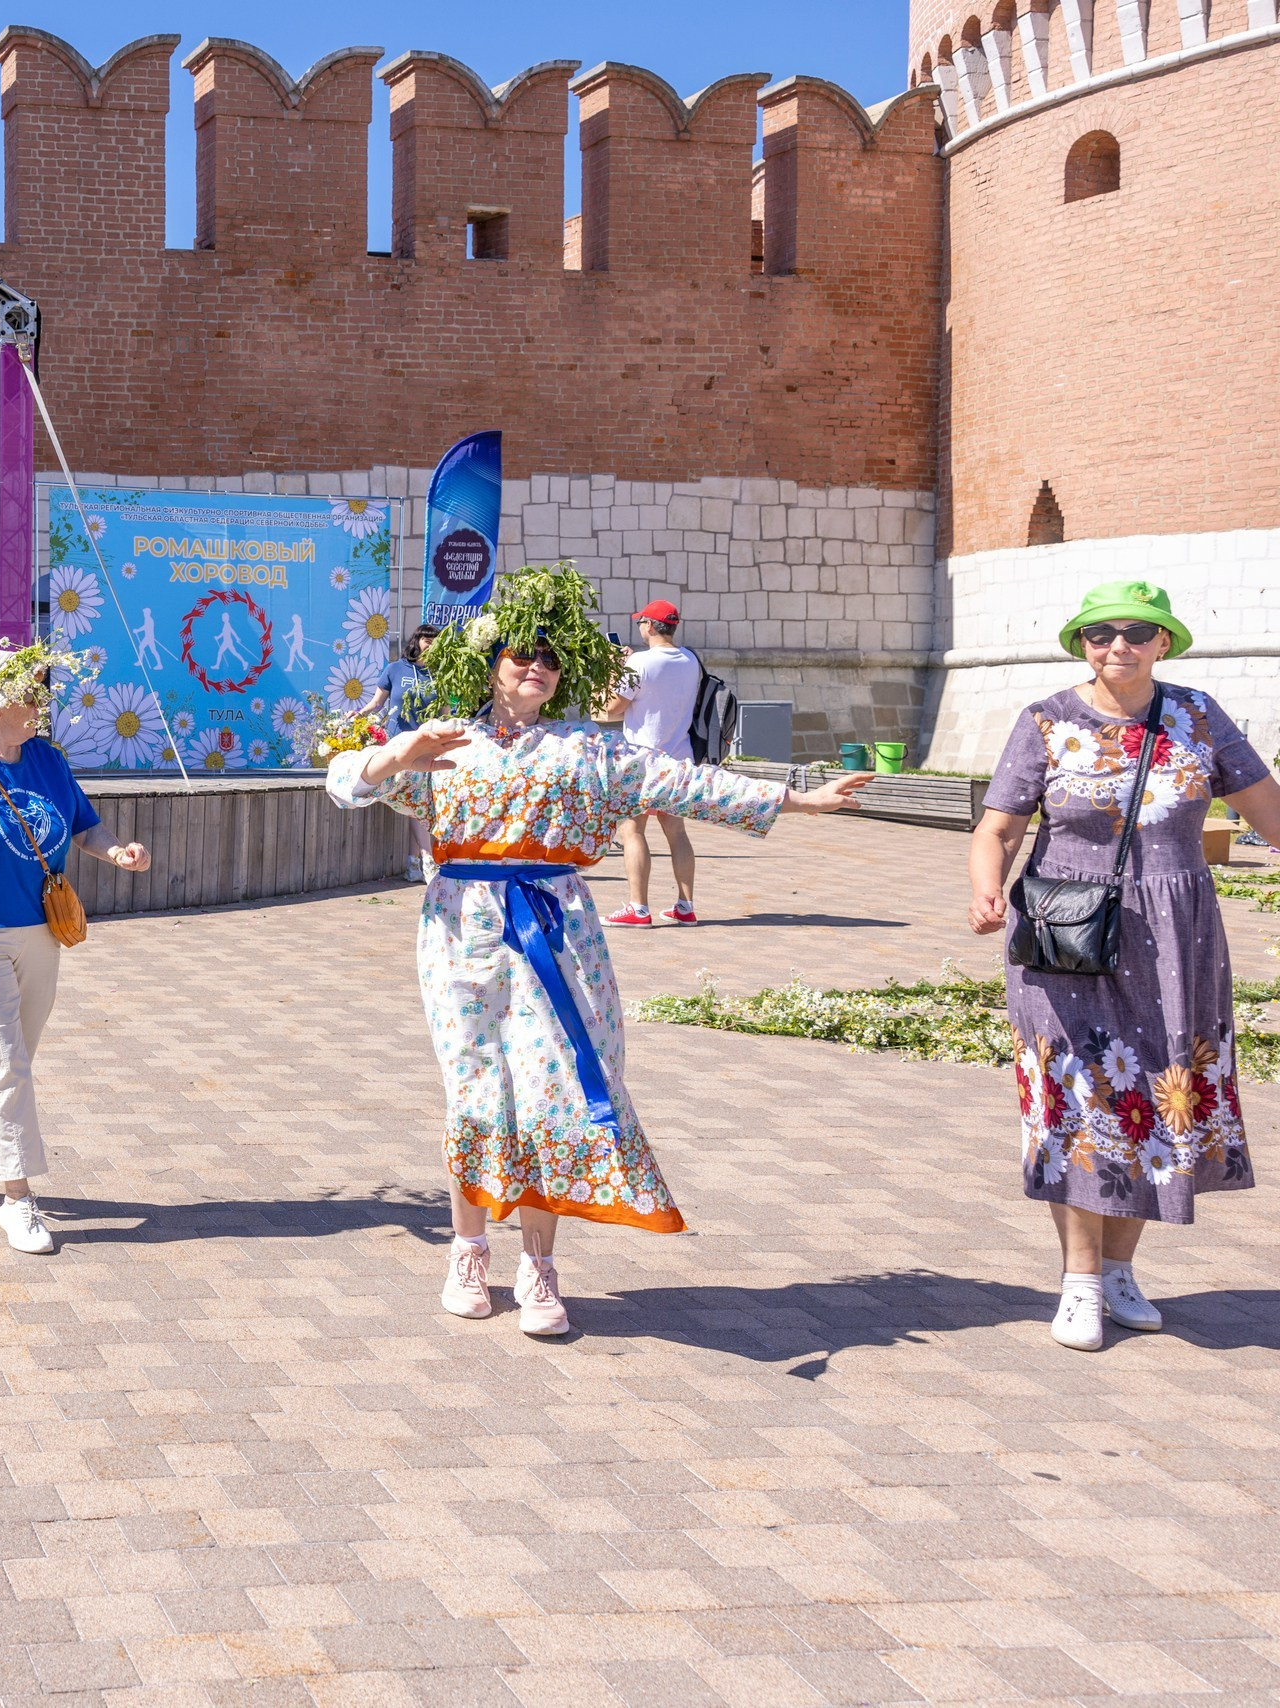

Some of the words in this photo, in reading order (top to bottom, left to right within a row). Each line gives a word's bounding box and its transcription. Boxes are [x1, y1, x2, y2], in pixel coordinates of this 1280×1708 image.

[101, 504, 161, 513] РЕГИОНАЛЬНАЯ
[273, 511, 331, 521] ОБЩЕСТВЕННАЯ
[332, 514, 383, 522] ОРГАНИЗАЦИЯ
[164, 515, 208, 523] ОБЛАСТНАЯ
[210, 517, 255, 525] ФЕДЕРАЦИЯ
[256, 519, 294, 527] СЕВЕРНОЙ
[133, 536, 316, 563] РОМАШКОВЫЙ
[443, 552, 483, 562] ФЕДЕРАЦИЯ
[446, 562, 480, 571] СЕВЕРНОЙ
[170, 562, 288, 588] ХОРОВОД
[208, 709, 245, 721] ТУЛА
